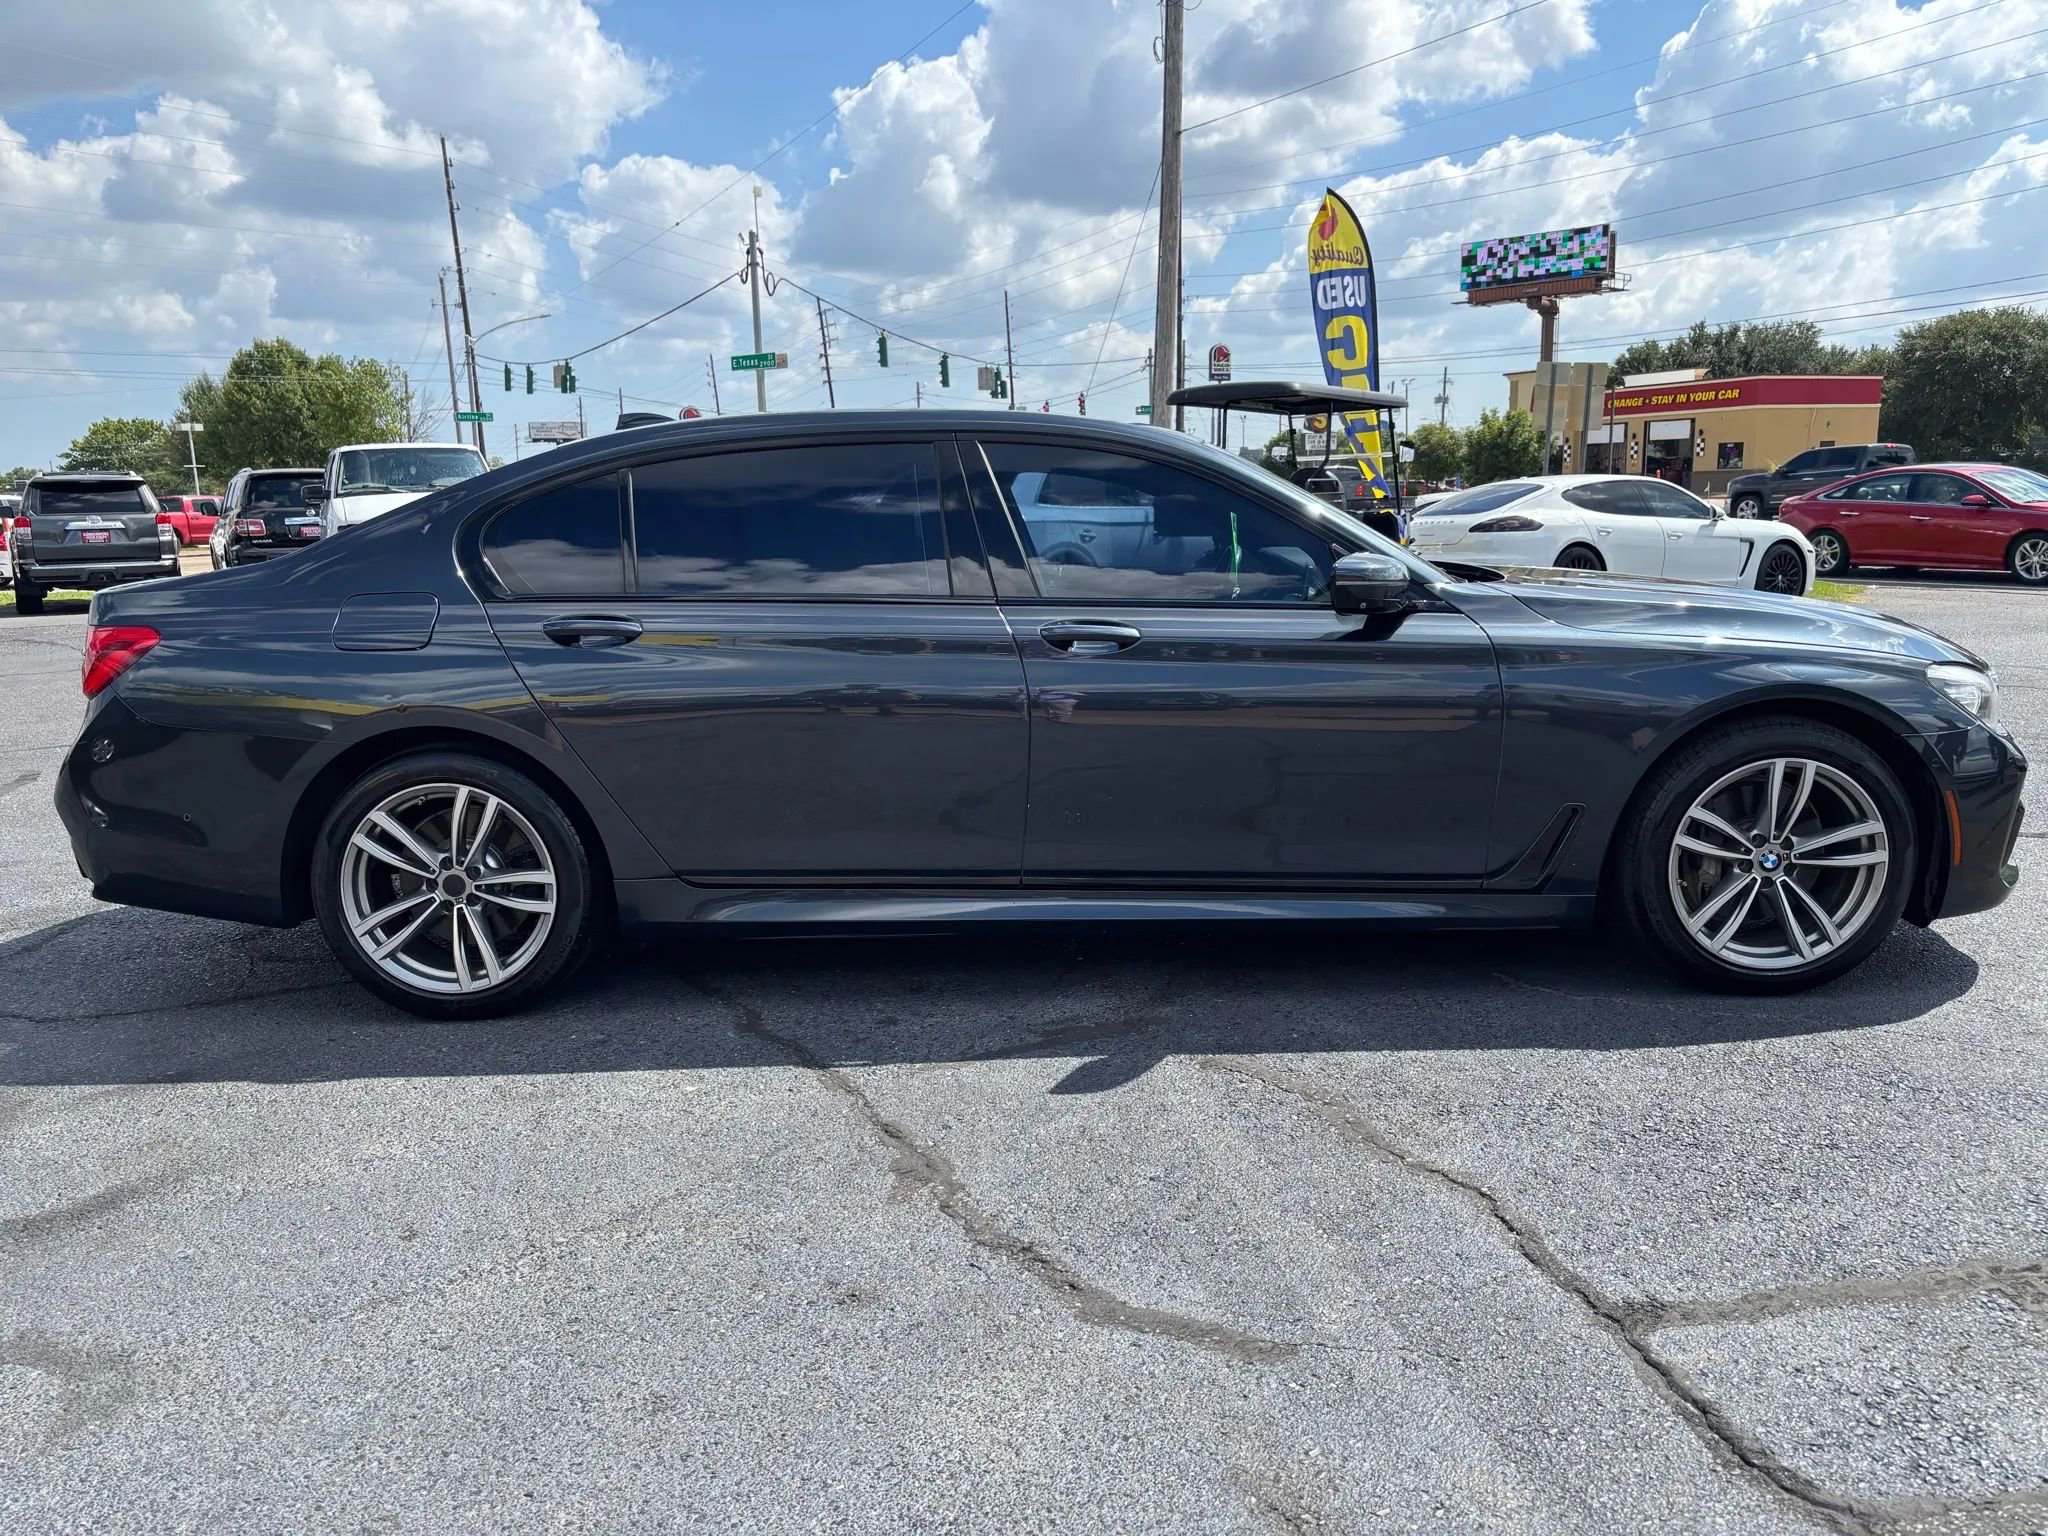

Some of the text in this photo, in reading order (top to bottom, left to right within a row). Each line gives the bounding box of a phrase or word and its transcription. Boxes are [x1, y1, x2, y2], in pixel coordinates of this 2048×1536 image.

[1650, 394, 1675, 405] STAY
[1676, 393, 1688, 403] IN
[1689, 391, 1716, 401] YOUR
[1718, 389, 1740, 400] CAR
